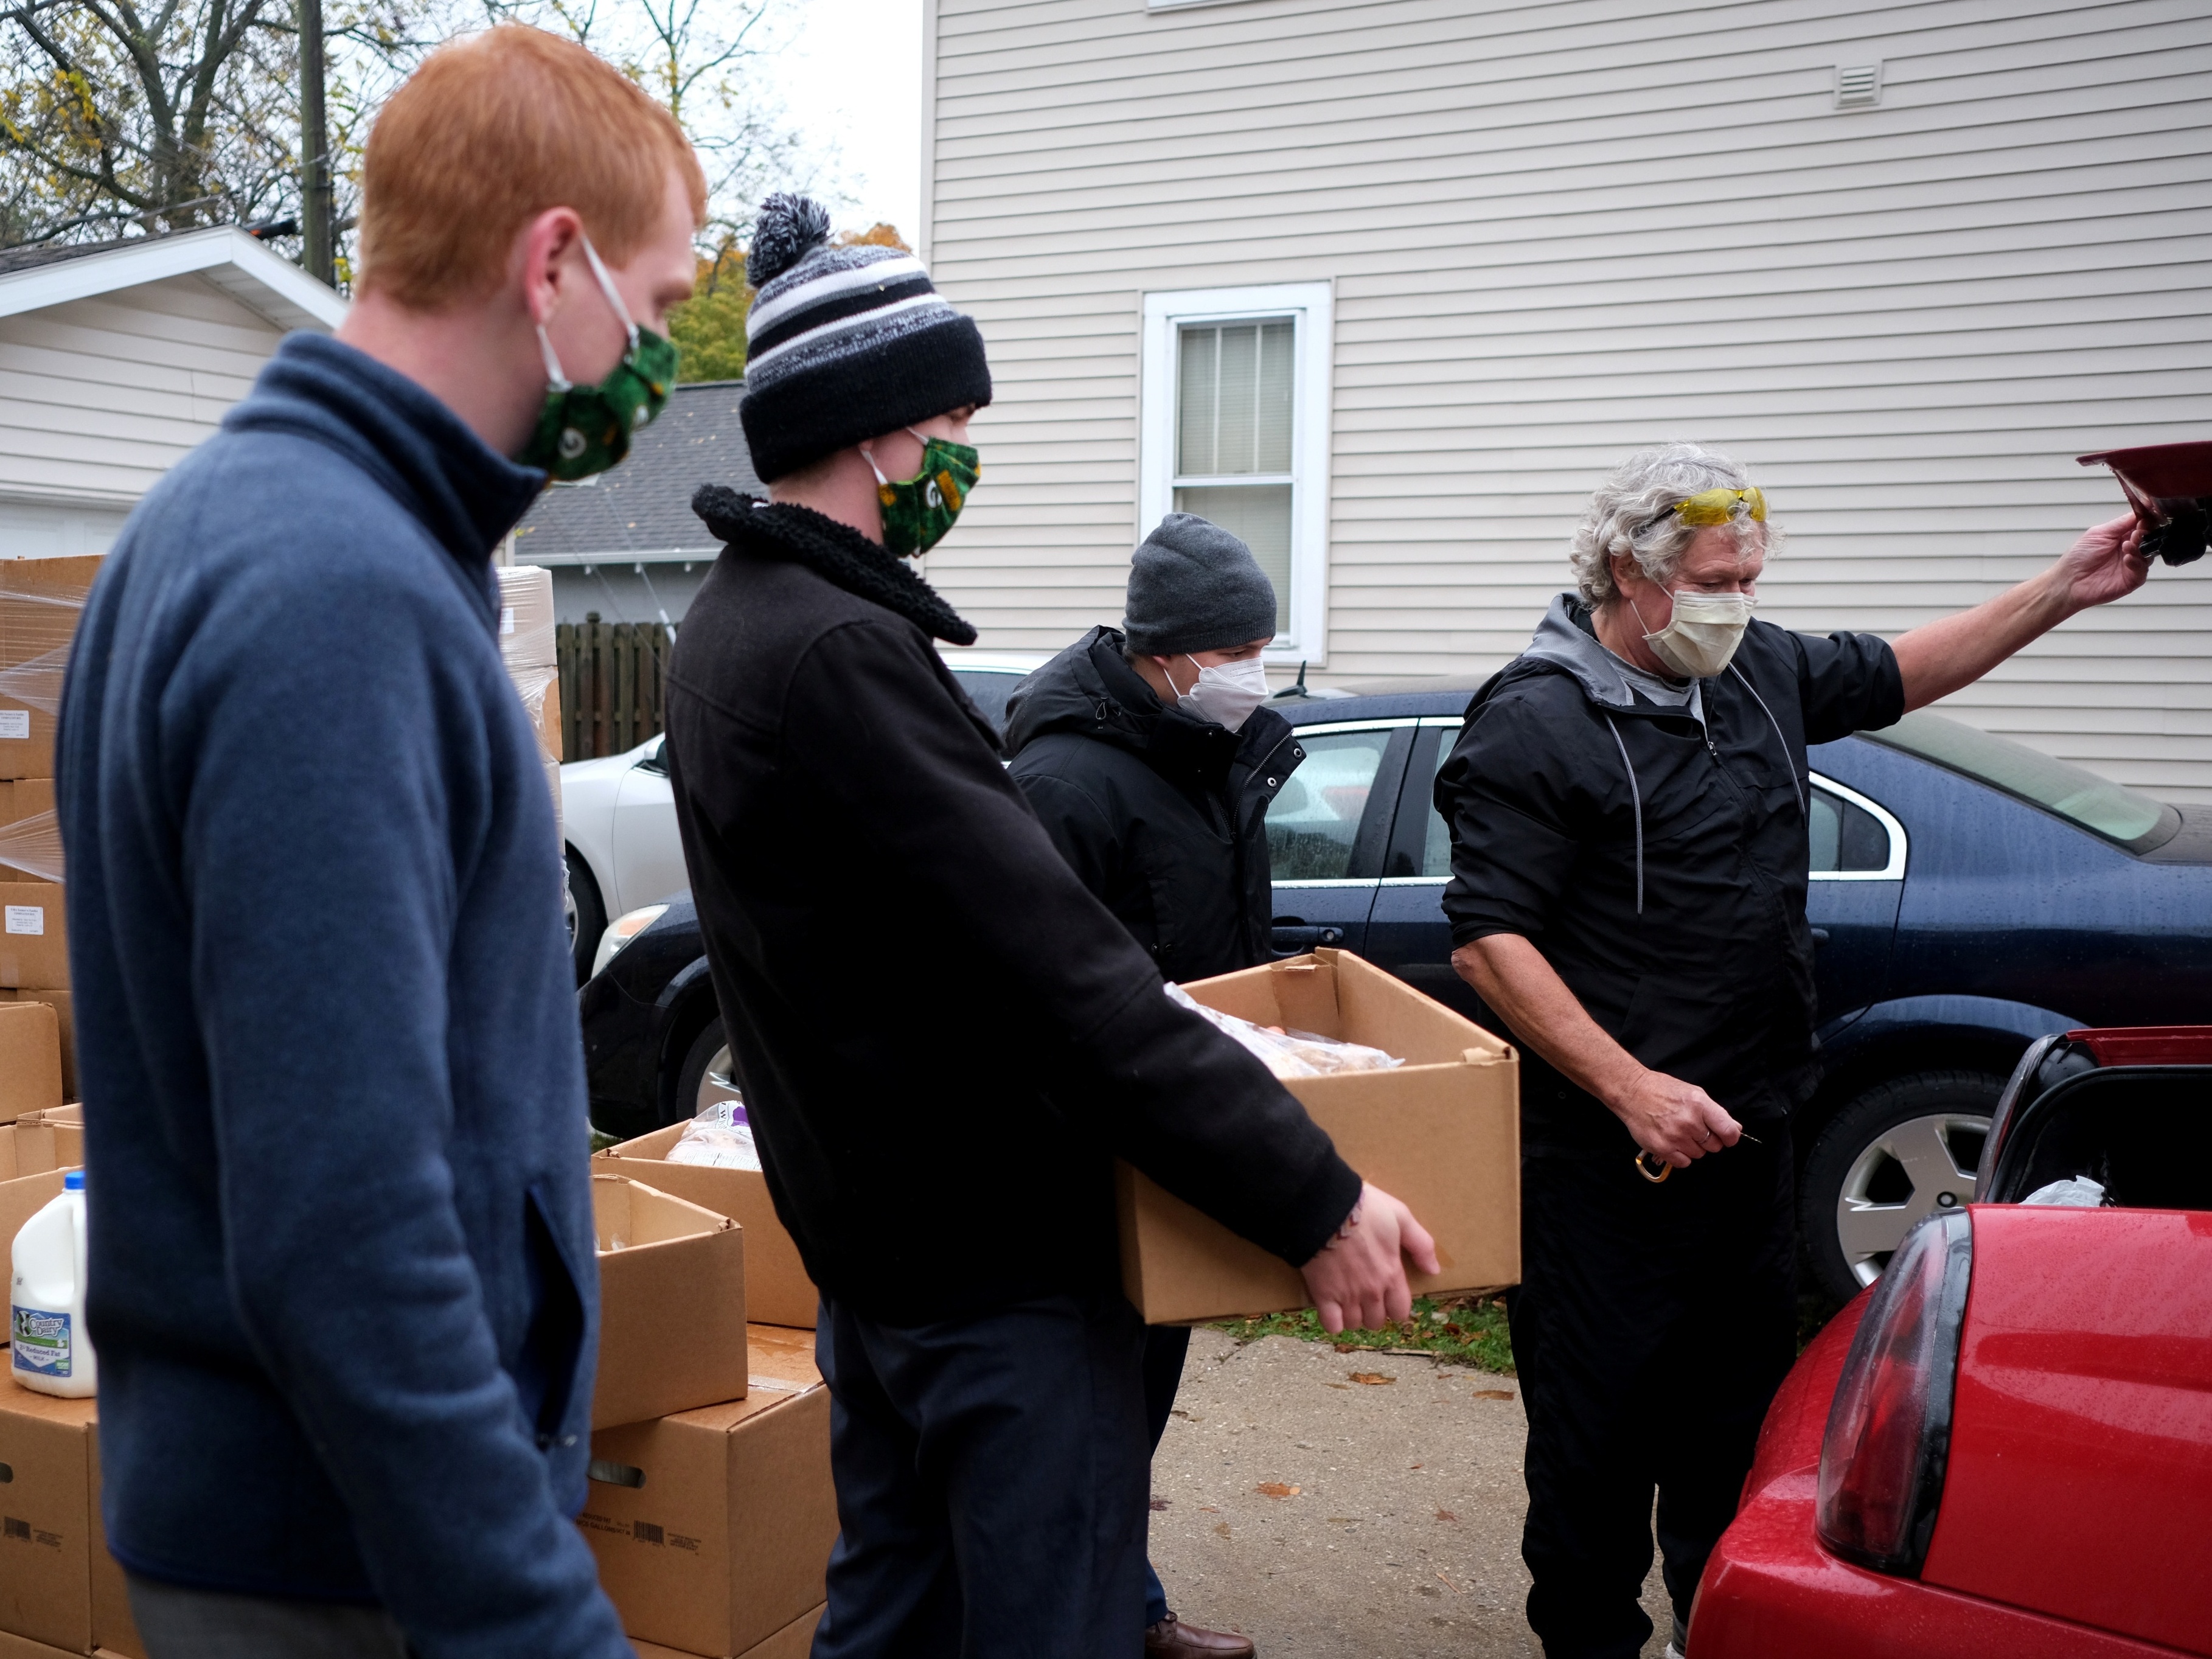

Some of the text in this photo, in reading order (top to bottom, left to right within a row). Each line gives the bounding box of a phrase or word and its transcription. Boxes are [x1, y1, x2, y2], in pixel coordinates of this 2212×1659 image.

[30, 1319, 62, 1329] Country
[37, 1327, 57, 1335] Dairy
[26, 1346, 49, 1355] Reduced
